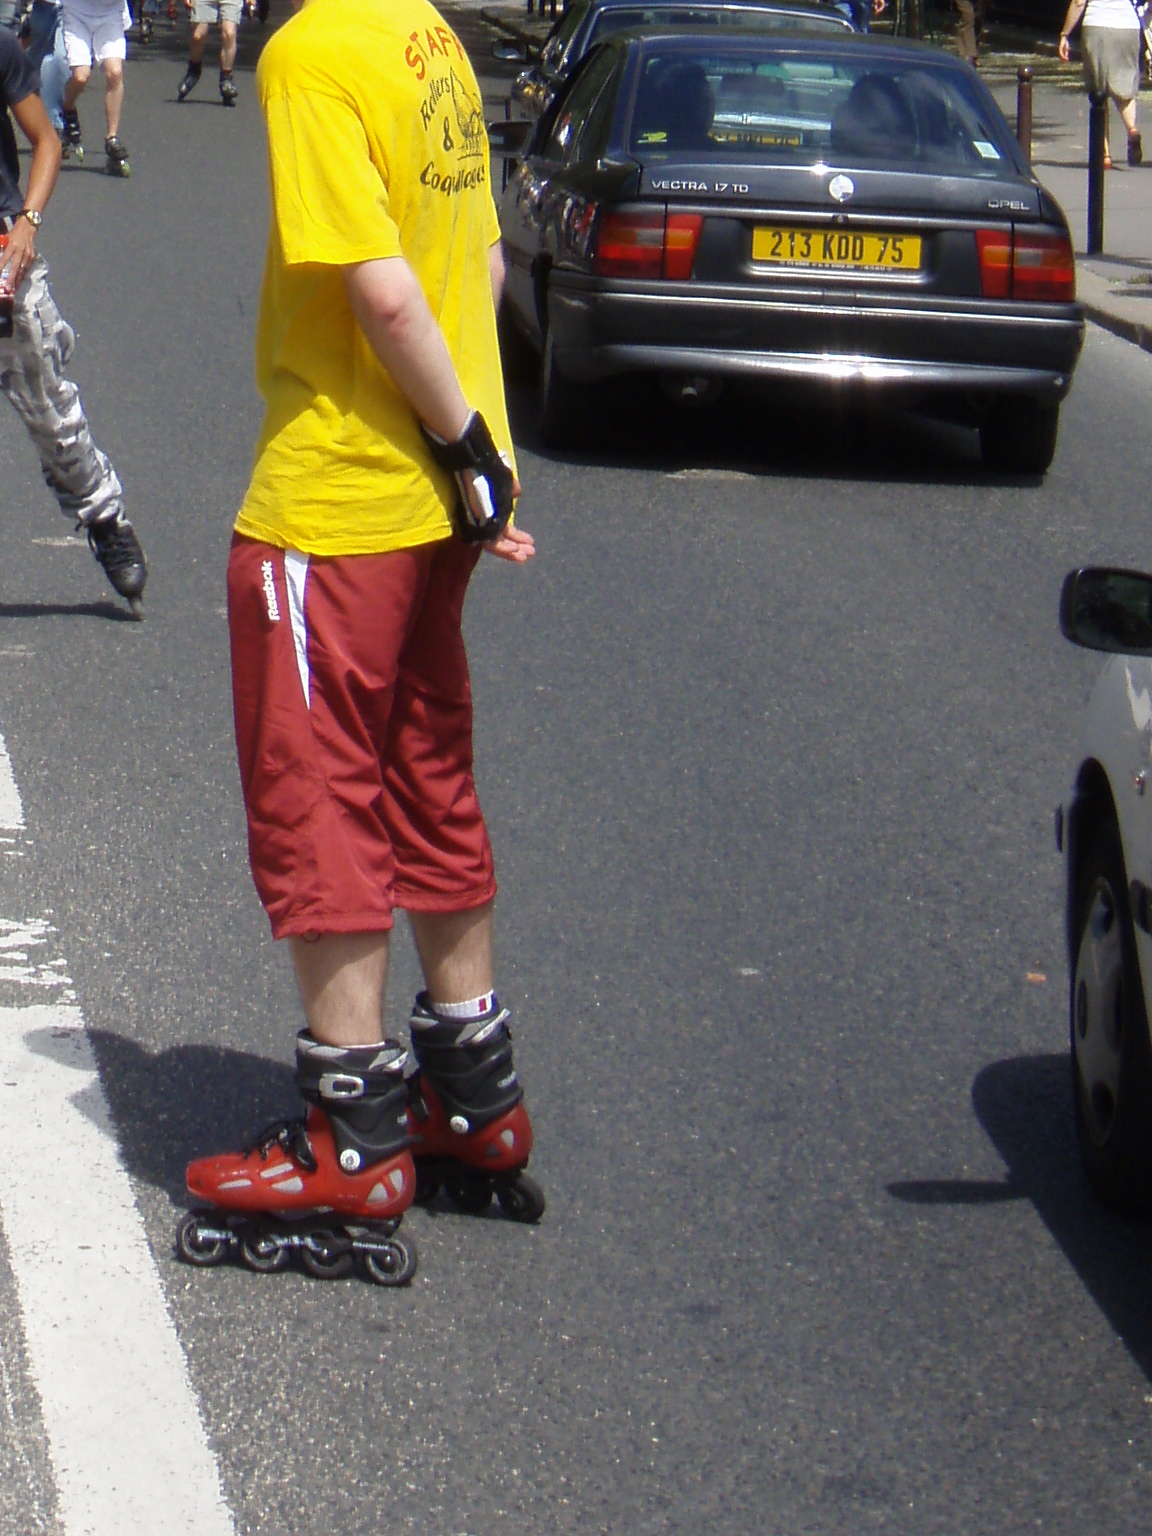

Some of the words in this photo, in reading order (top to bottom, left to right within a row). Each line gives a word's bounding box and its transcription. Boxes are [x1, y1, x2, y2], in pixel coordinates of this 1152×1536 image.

[420, 76, 450, 132] Rollers
[442, 116, 454, 151] &
[651, 180, 708, 192] VECTRA
[732, 183, 749, 193] TD
[987, 199, 1030, 210] OPEL
[770, 230, 813, 257] 213
[822, 233, 864, 261] KDD
[877, 236, 904, 263] 75
[261, 560, 281, 622] Reebok
